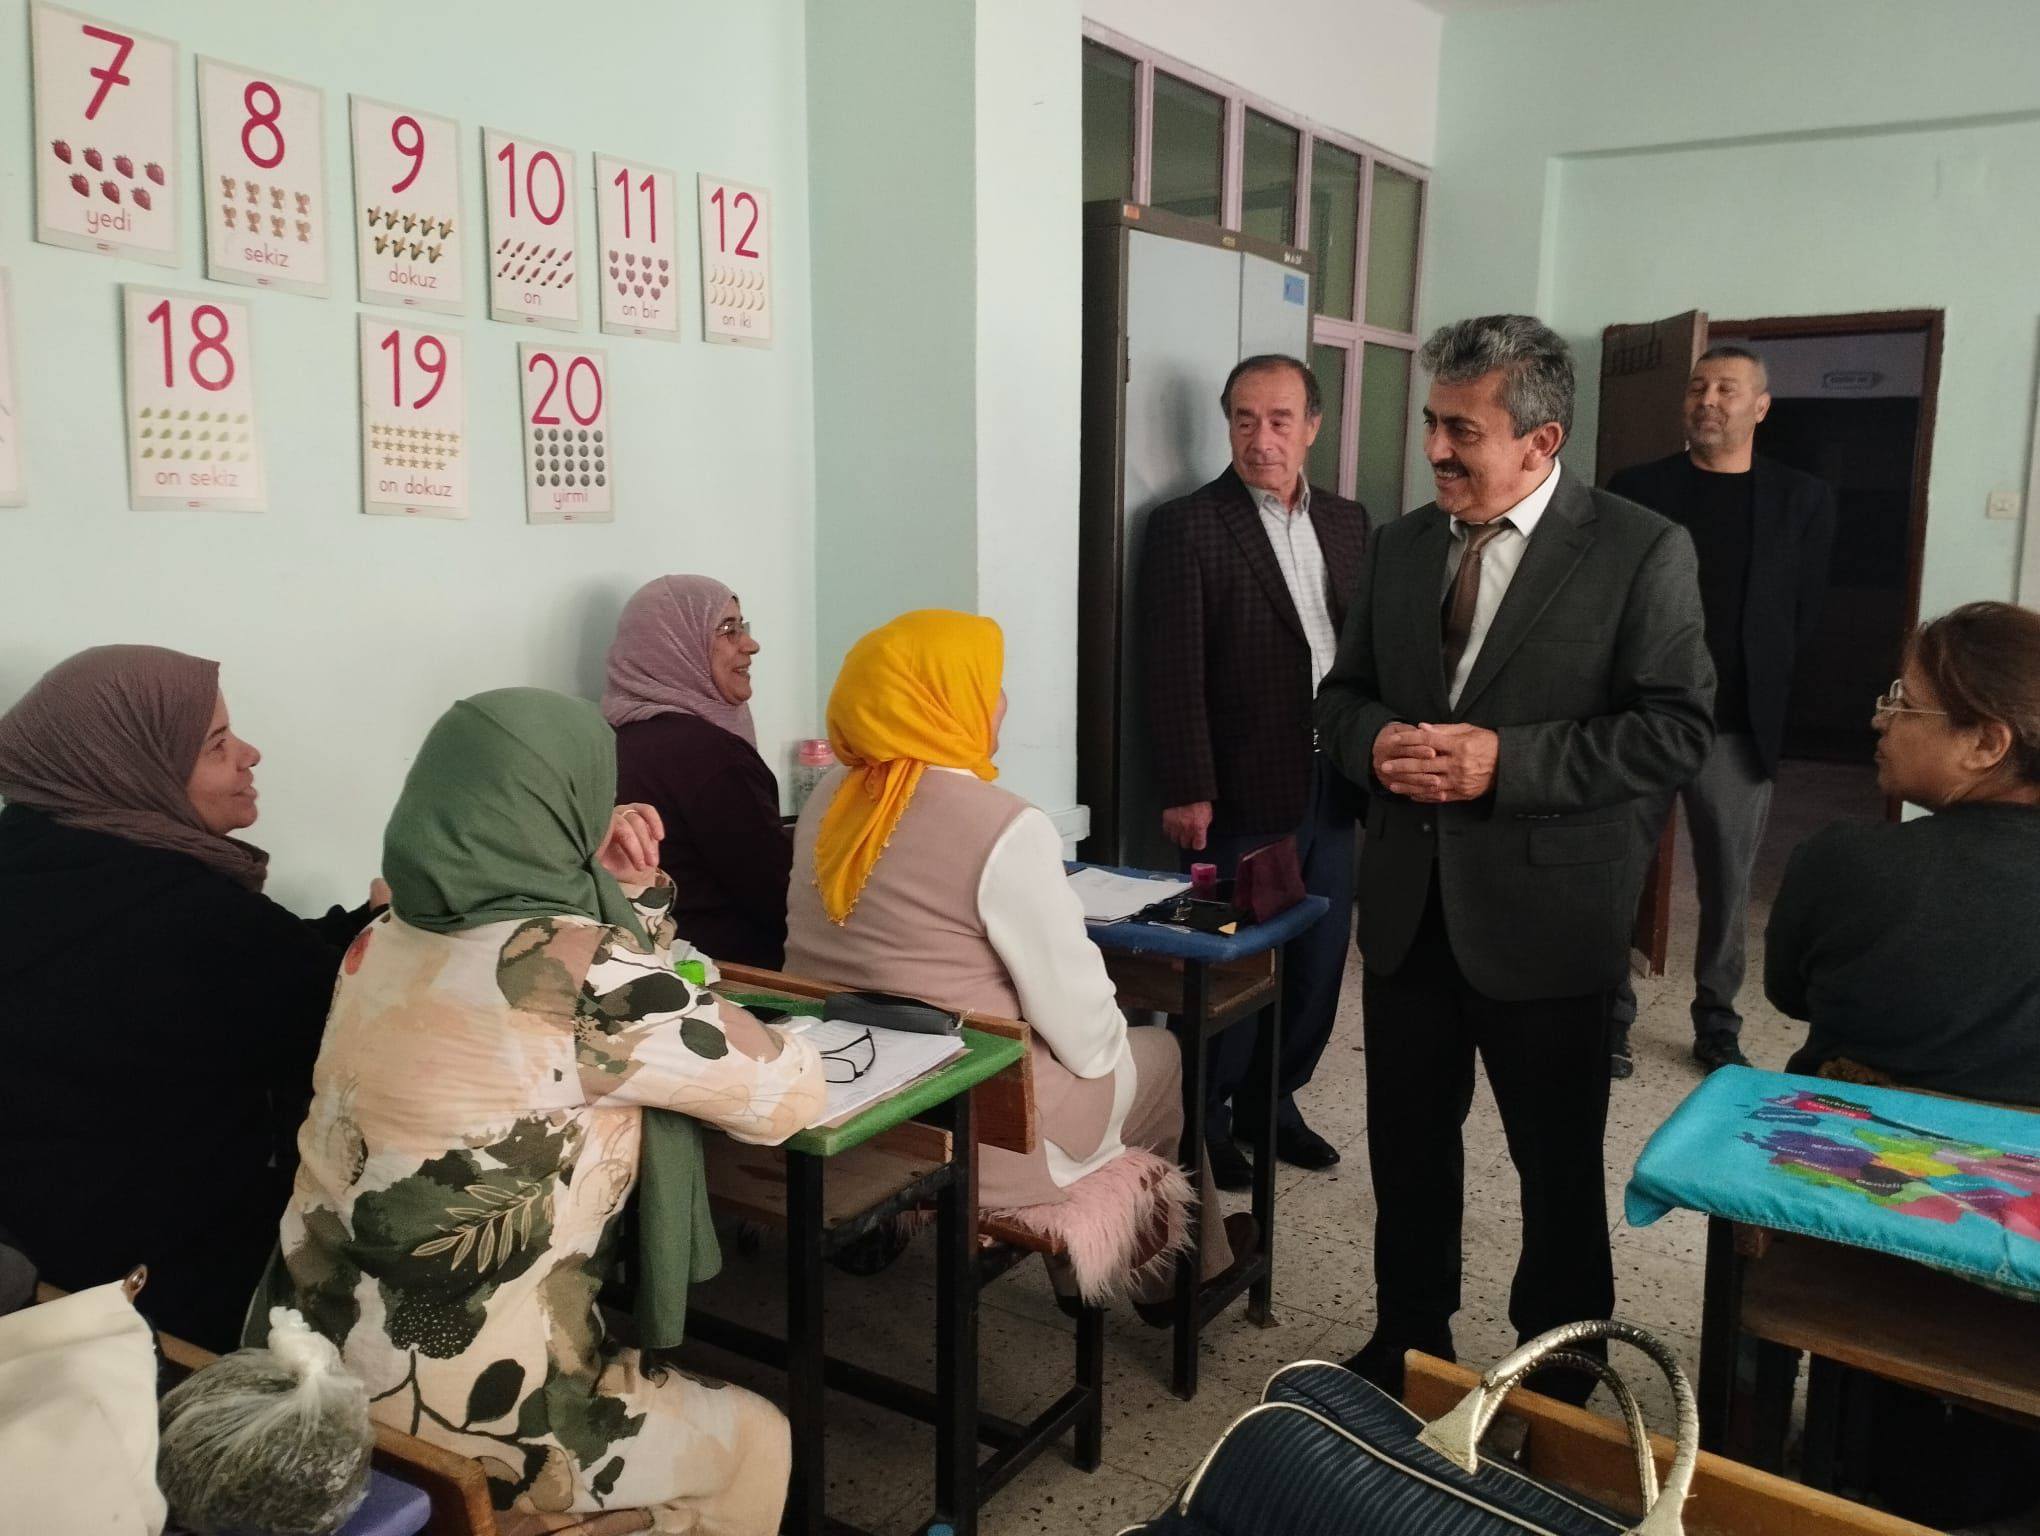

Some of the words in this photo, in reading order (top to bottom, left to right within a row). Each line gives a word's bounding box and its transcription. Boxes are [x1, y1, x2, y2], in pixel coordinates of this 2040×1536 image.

[82, 25, 134, 120] 7
[241, 81, 285, 169] 8
[391, 116, 425, 194] 9
[498, 142, 565, 226] 10
[614, 168, 657, 243] 11
[86, 208, 133, 234] yedi
[710, 187, 759, 259] 12
[244, 243, 290, 268] sekiz
[389, 263, 437, 289] dokuz
[523, 290, 542, 306] on
[622, 303, 637, 317] on
[642, 301, 660, 319] bir
[722, 312, 737, 327] on
[739, 311, 753, 329] iki
[148, 300, 235, 391] 18
[381, 330, 447, 410] 19
[528, 353, 603, 426] 20
[155, 471, 181, 487] on
[189, 469, 241, 489] sekiz
[379, 478, 399, 494] on
[405, 475, 453, 498] dokuz
[552, 485, 590, 510] yirmi
